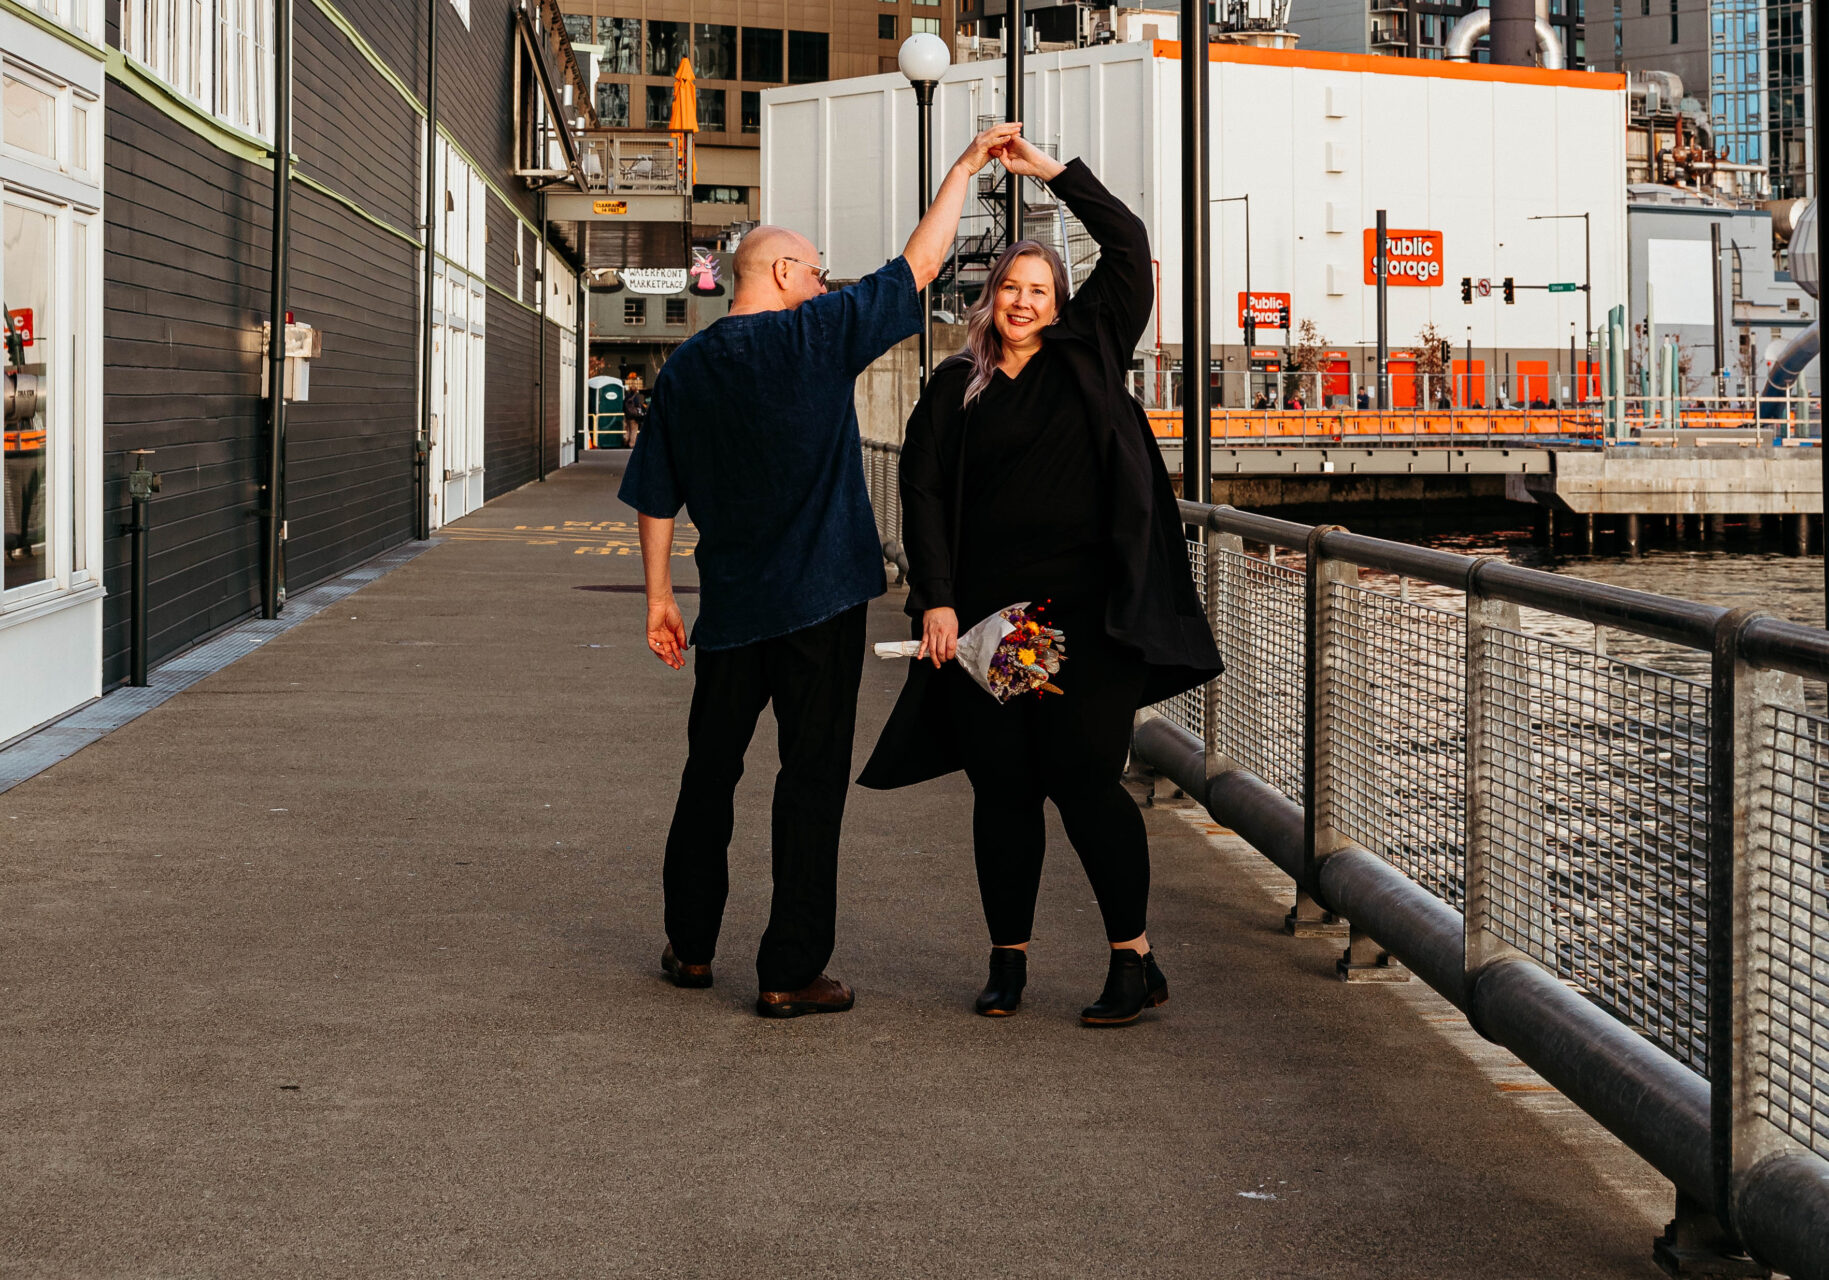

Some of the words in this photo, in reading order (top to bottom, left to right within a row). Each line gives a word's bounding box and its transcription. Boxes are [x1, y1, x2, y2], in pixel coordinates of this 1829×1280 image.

[629, 268, 683, 278] WATERFRONT
[1372, 256, 1440, 281] Sorage
[629, 279, 684, 289] MARKETPLACE
[1248, 296, 1284, 309] Public
[1242, 309, 1286, 326] Sorag
